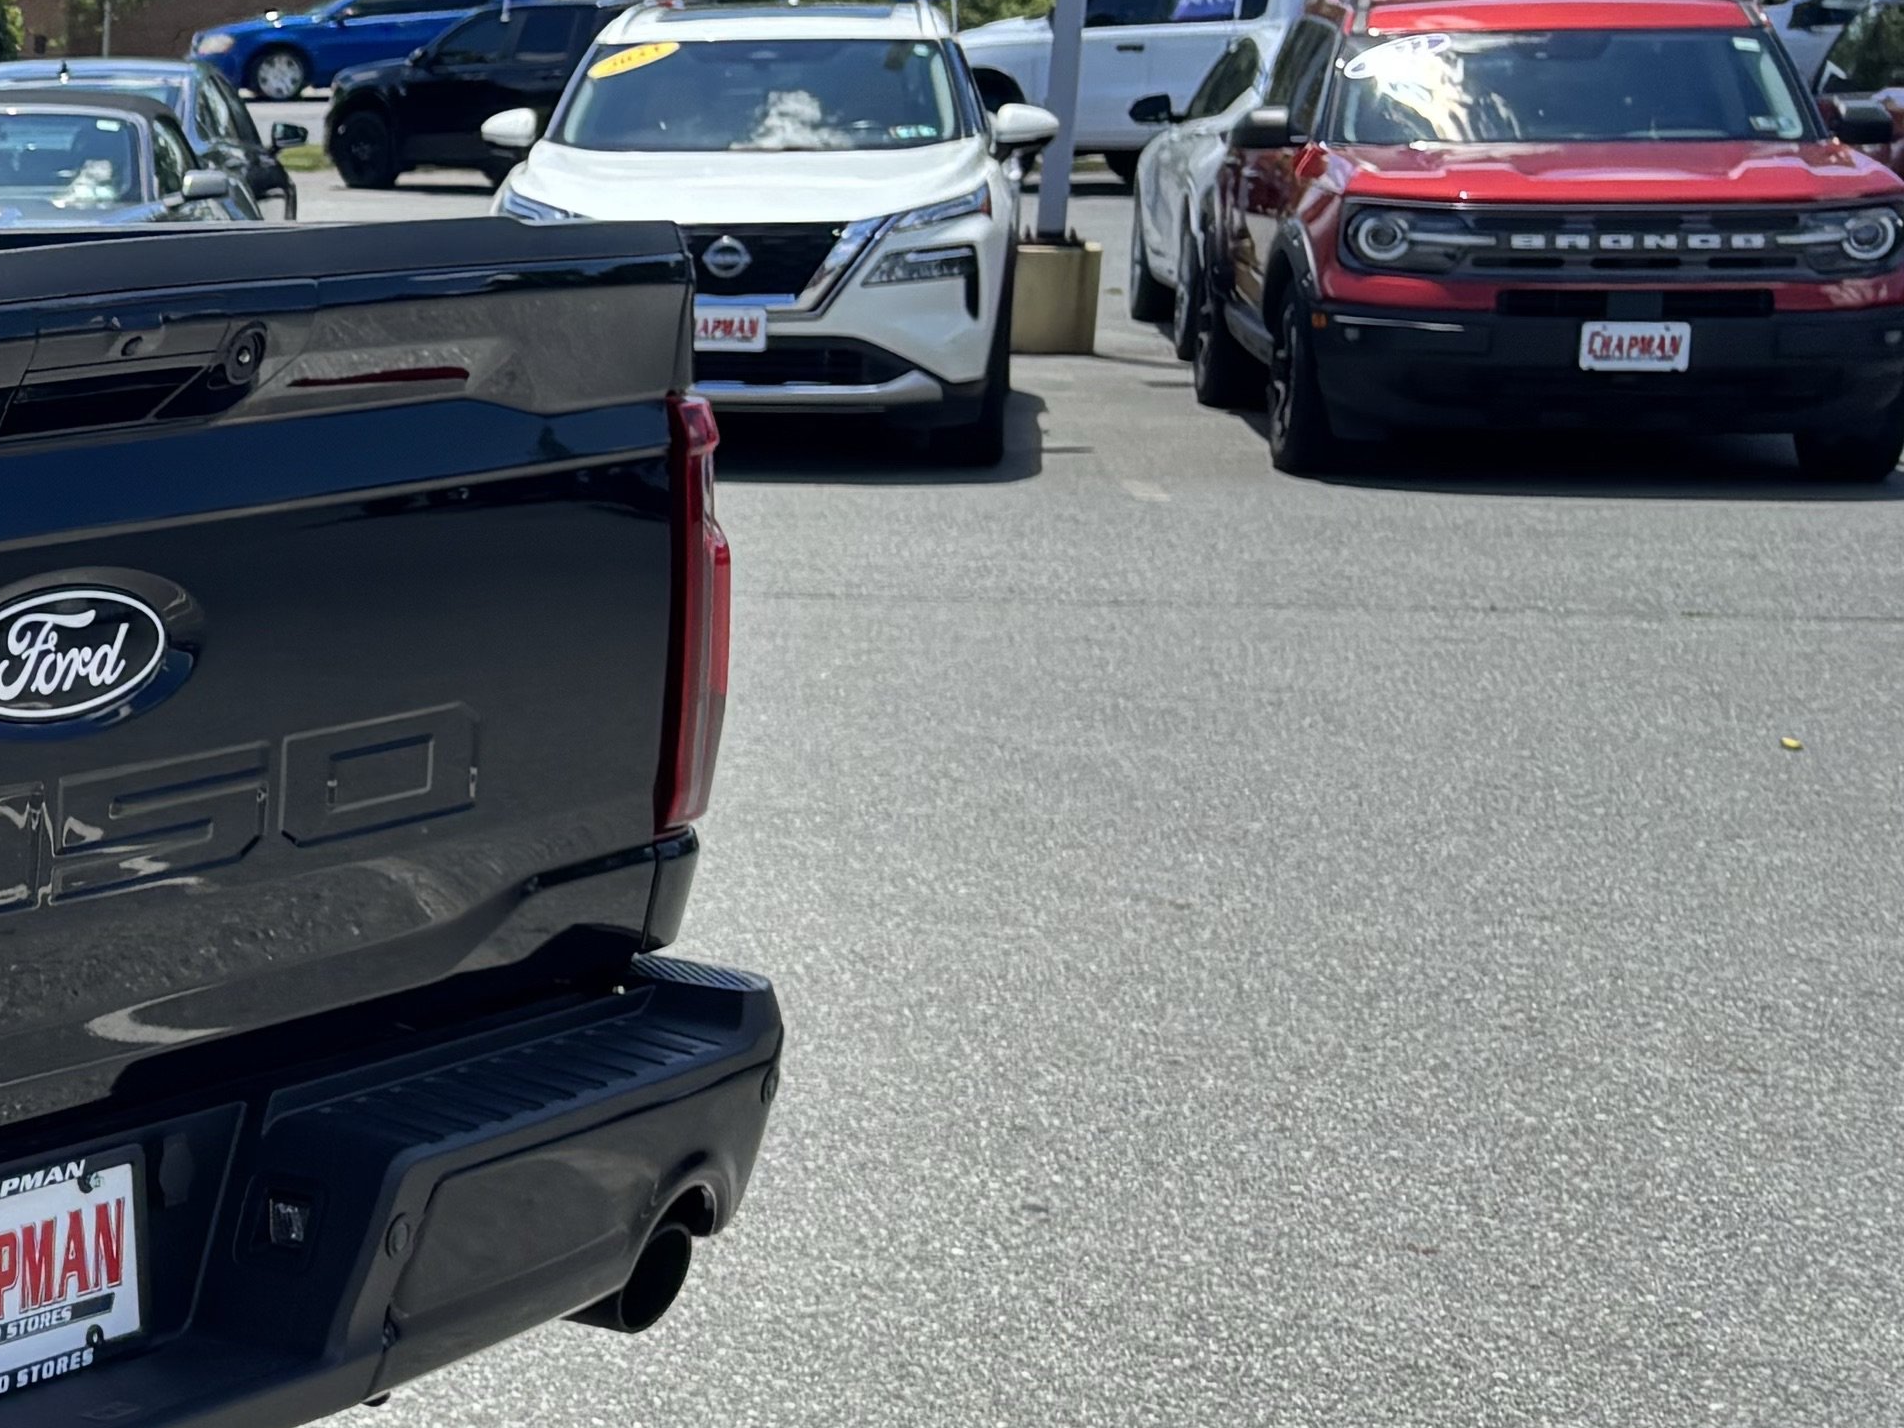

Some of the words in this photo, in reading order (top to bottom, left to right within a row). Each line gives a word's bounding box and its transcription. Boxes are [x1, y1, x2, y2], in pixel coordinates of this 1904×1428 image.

[1510, 233, 1766, 250] BRONCO
[697, 317, 759, 340] APMAN
[1587, 331, 1683, 357] CHAPMAN
[6, 1305, 73, 1338] STORES
[15, 1347, 95, 1388] STORES
